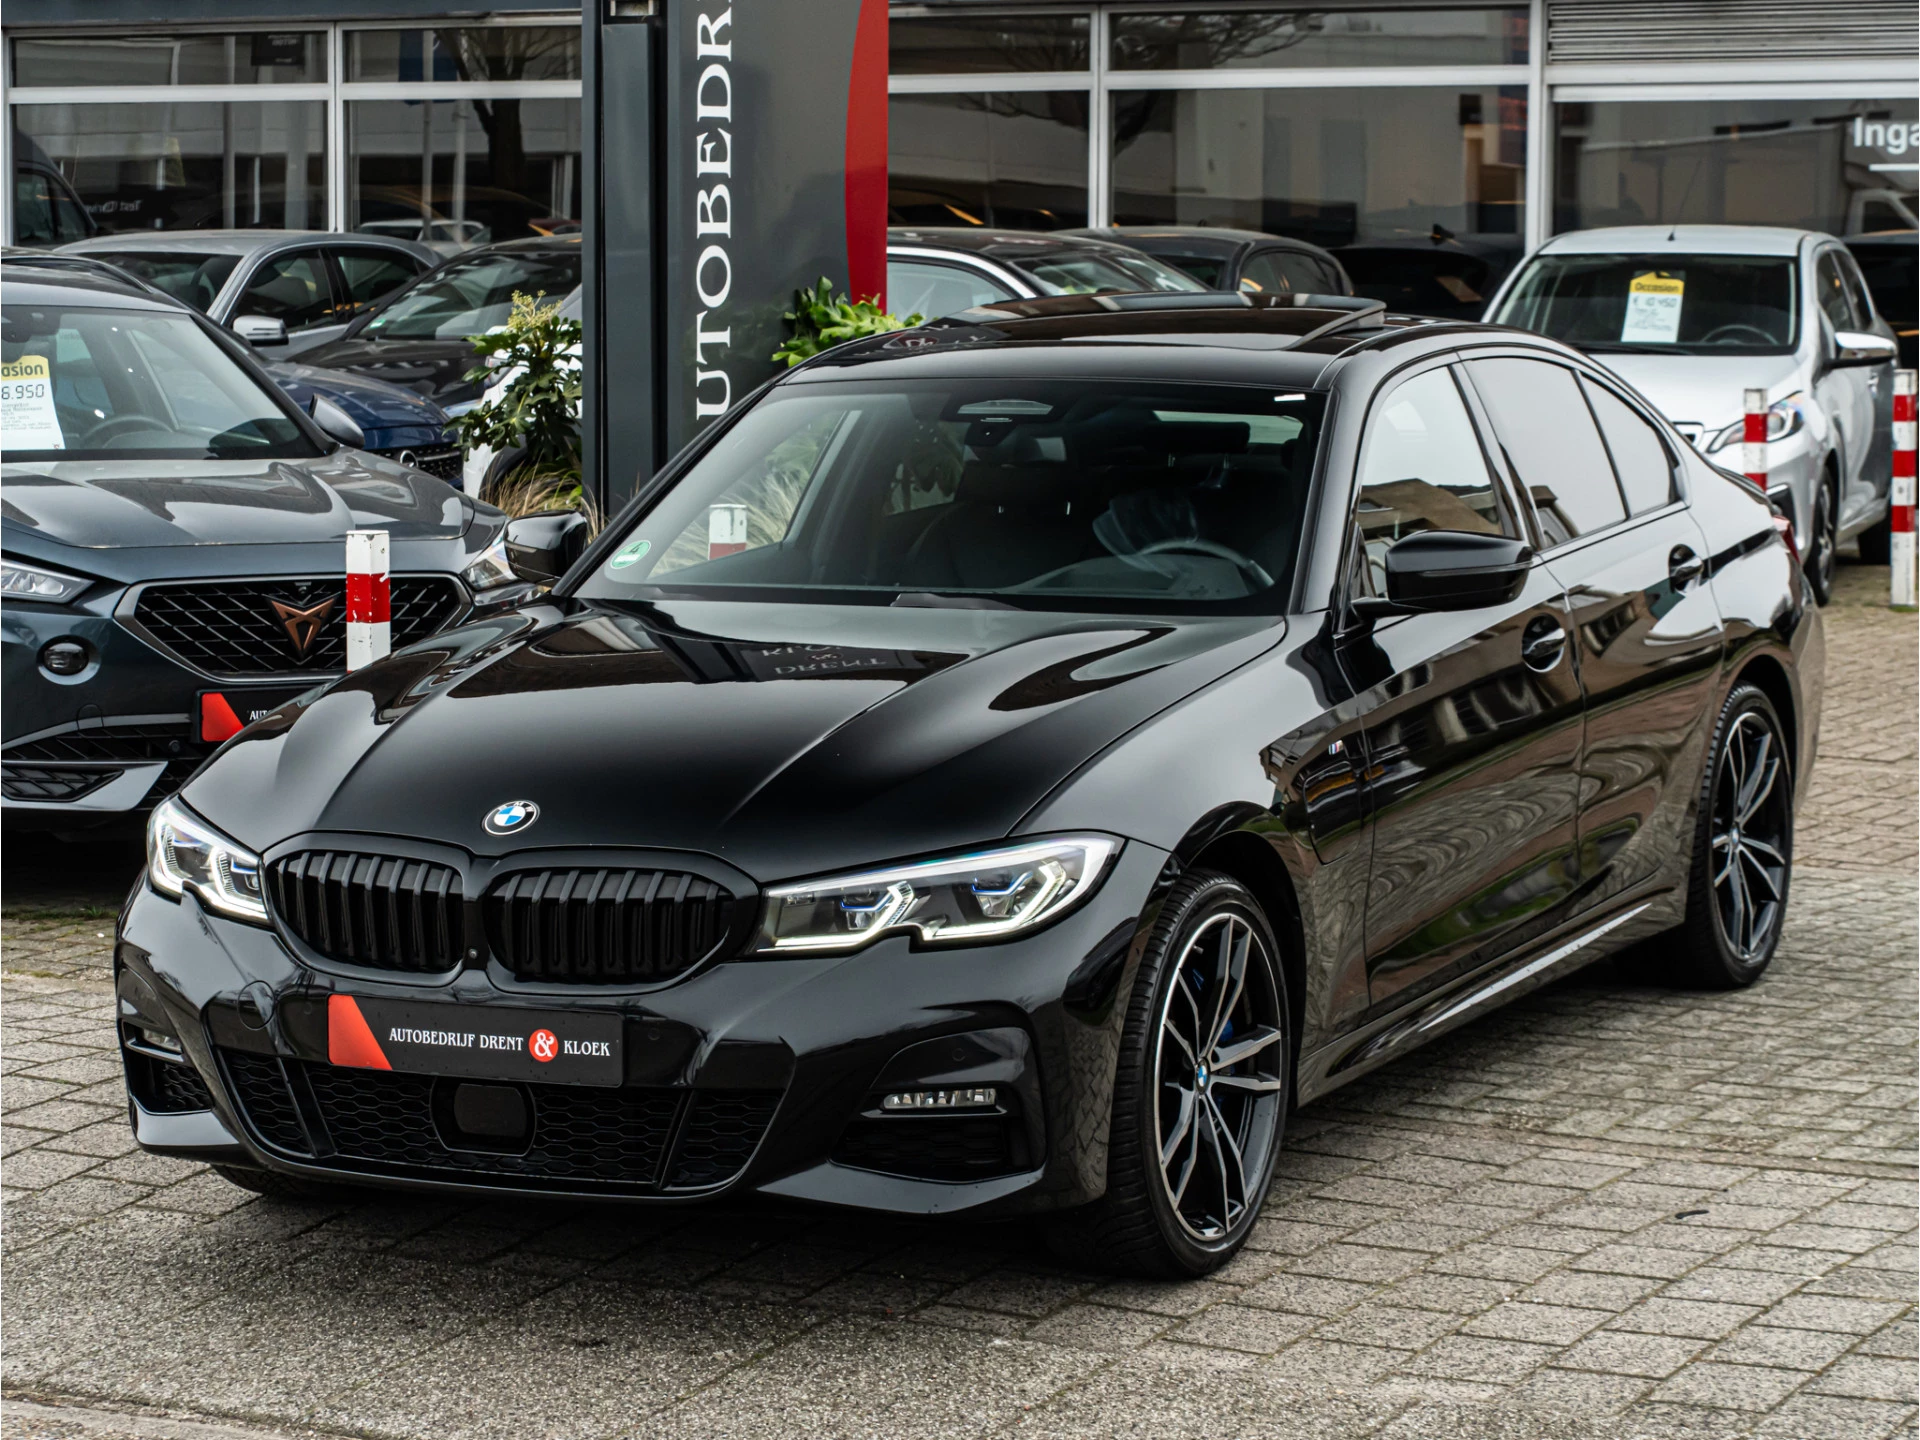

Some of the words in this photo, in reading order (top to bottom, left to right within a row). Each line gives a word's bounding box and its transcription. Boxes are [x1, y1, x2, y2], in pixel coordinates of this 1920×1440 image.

[696, 0, 732, 420] UTOBEDR
[1634, 282, 1680, 293] Occasion
[1, 362, 44, 377] asion
[1, 383, 45, 400] 6.950
[249, 709, 272, 720] AUT
[389, 1027, 476, 1048] AUTOBEDRIJF
[479, 1034, 524, 1051] DRENT
[534, 1032, 554, 1058] &
[563, 1040, 611, 1057] KLOEK
